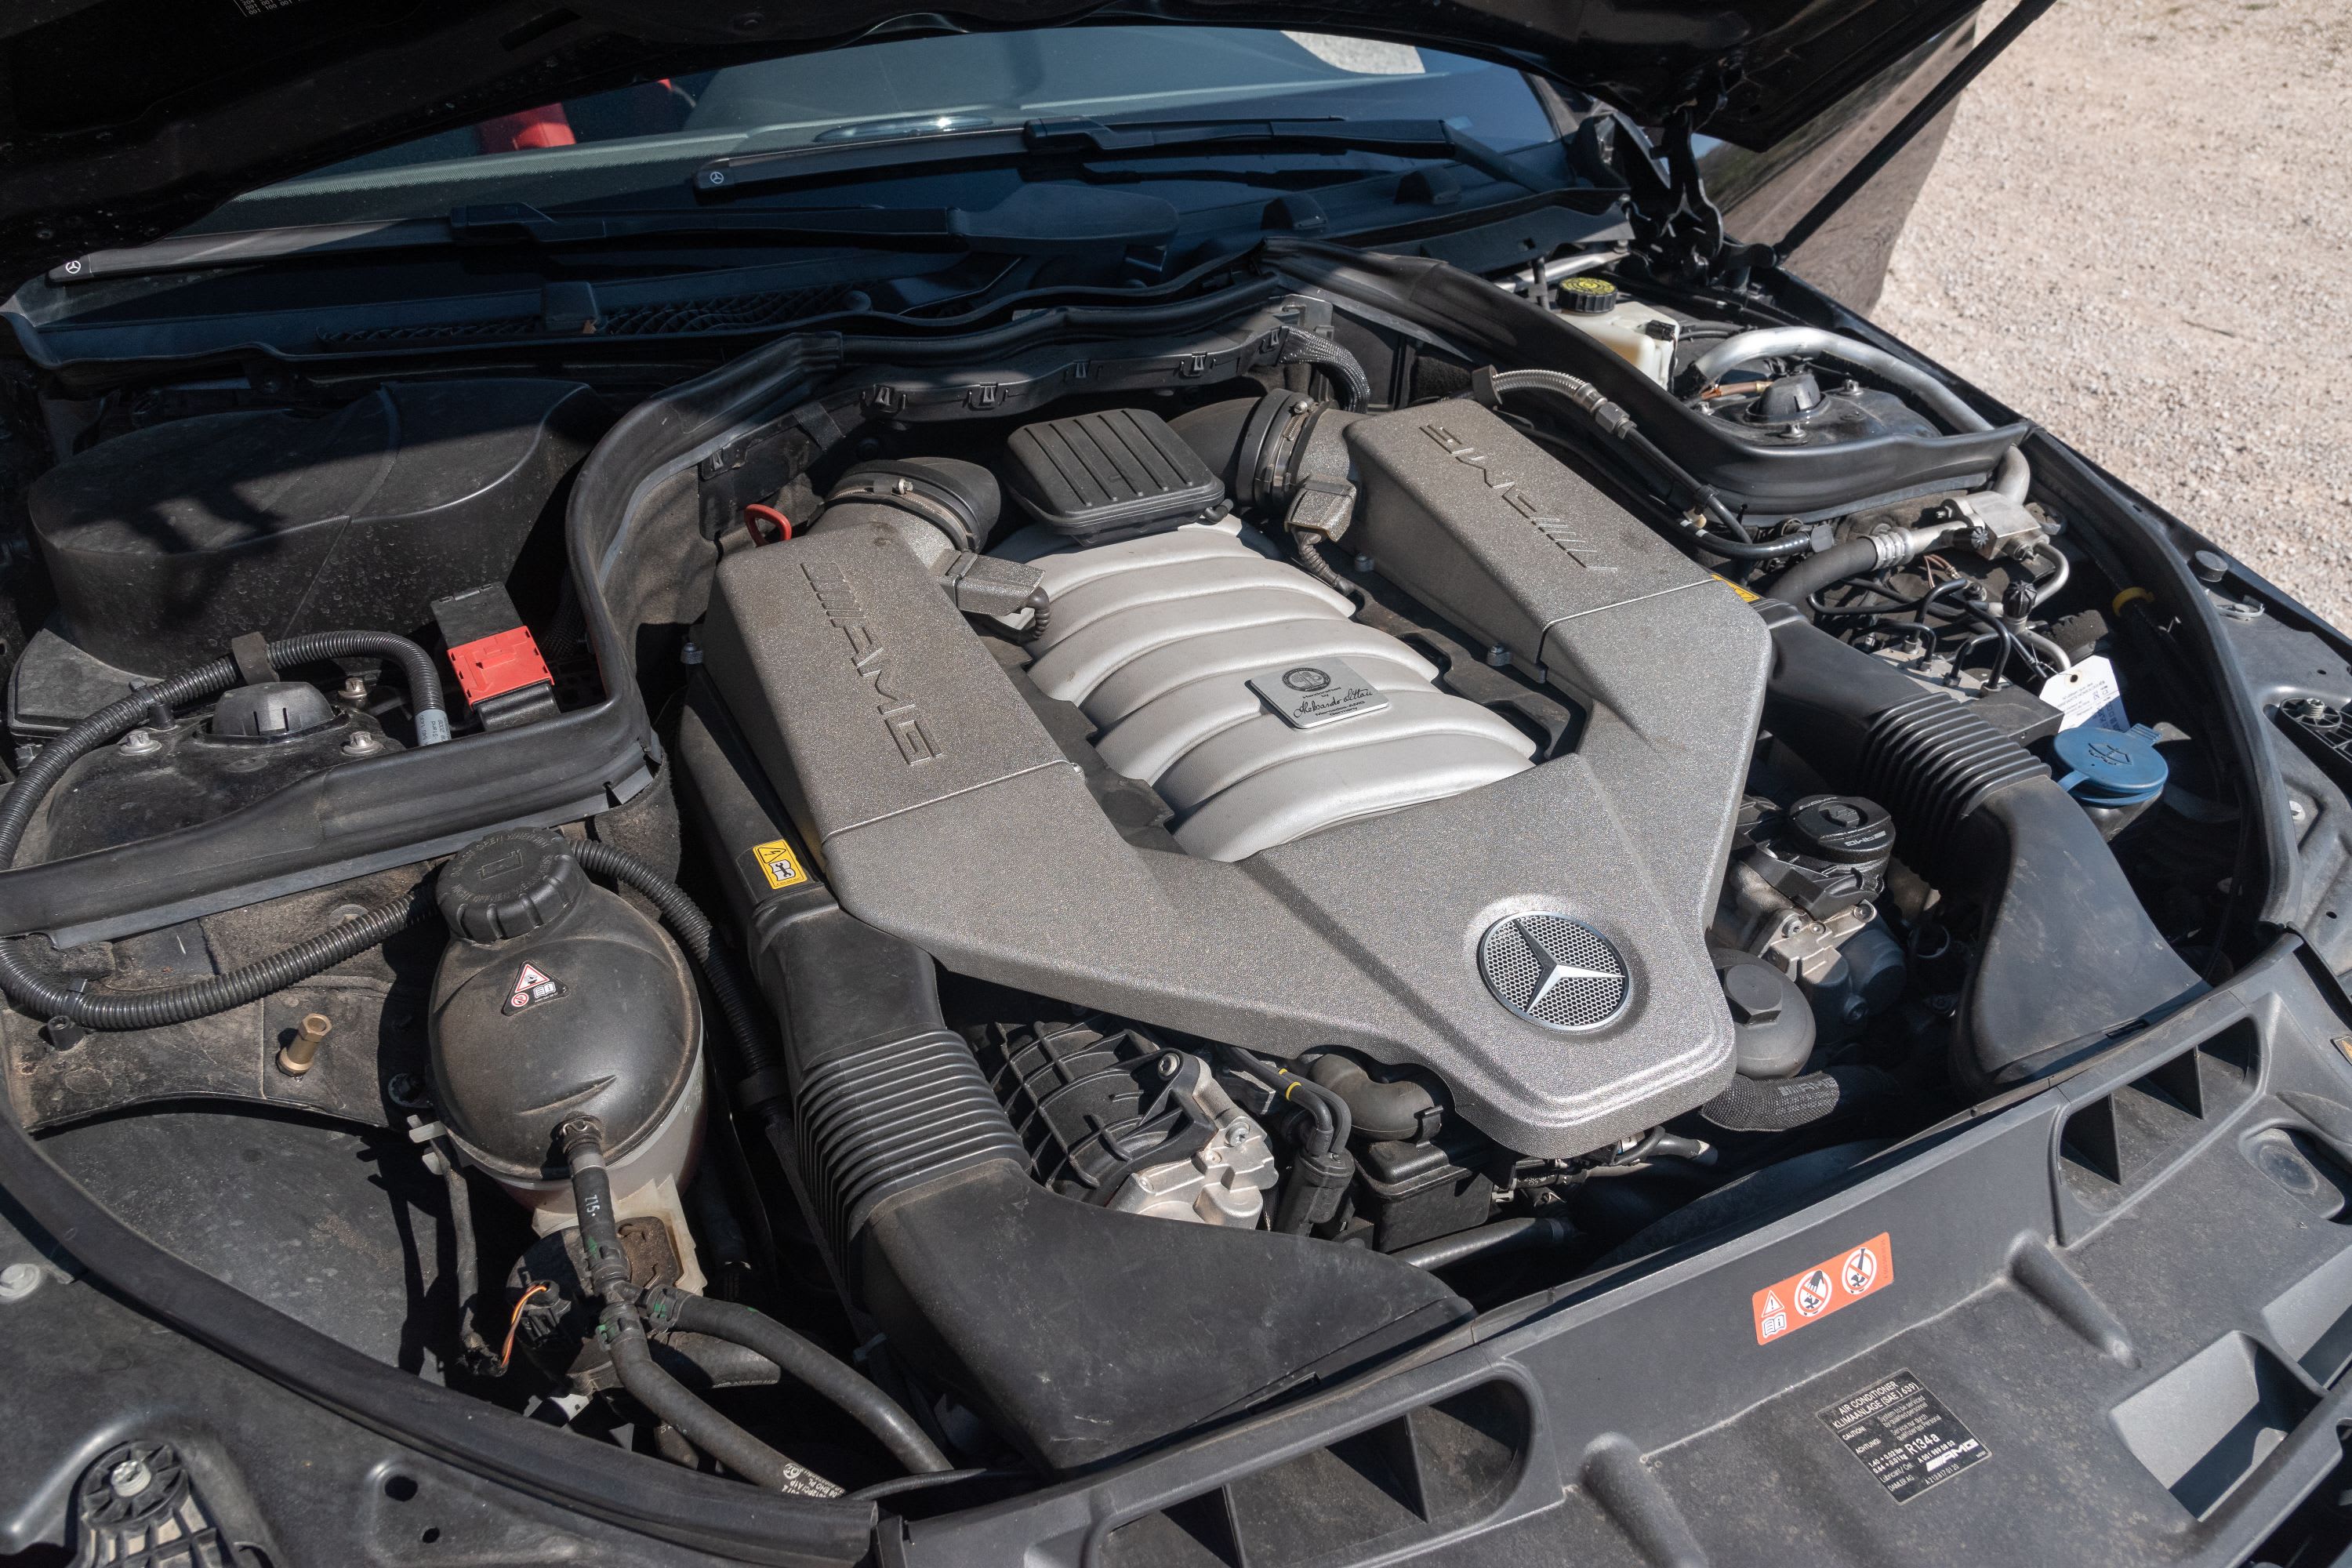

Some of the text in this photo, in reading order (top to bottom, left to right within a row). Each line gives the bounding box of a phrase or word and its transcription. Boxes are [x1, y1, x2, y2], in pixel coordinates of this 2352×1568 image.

[1832, 1399, 1884, 1429] KLIMAANLAGE
[1880, 1392, 1900, 1406] (SAE
[1902, 1381, 1920, 1394] 639)
[1838, 1381, 1899, 1415] AIR CONDITIONER
[1855, 1437, 1882, 1454] ACHTUNG!
[1904, 1433, 1940, 1455] R134a
